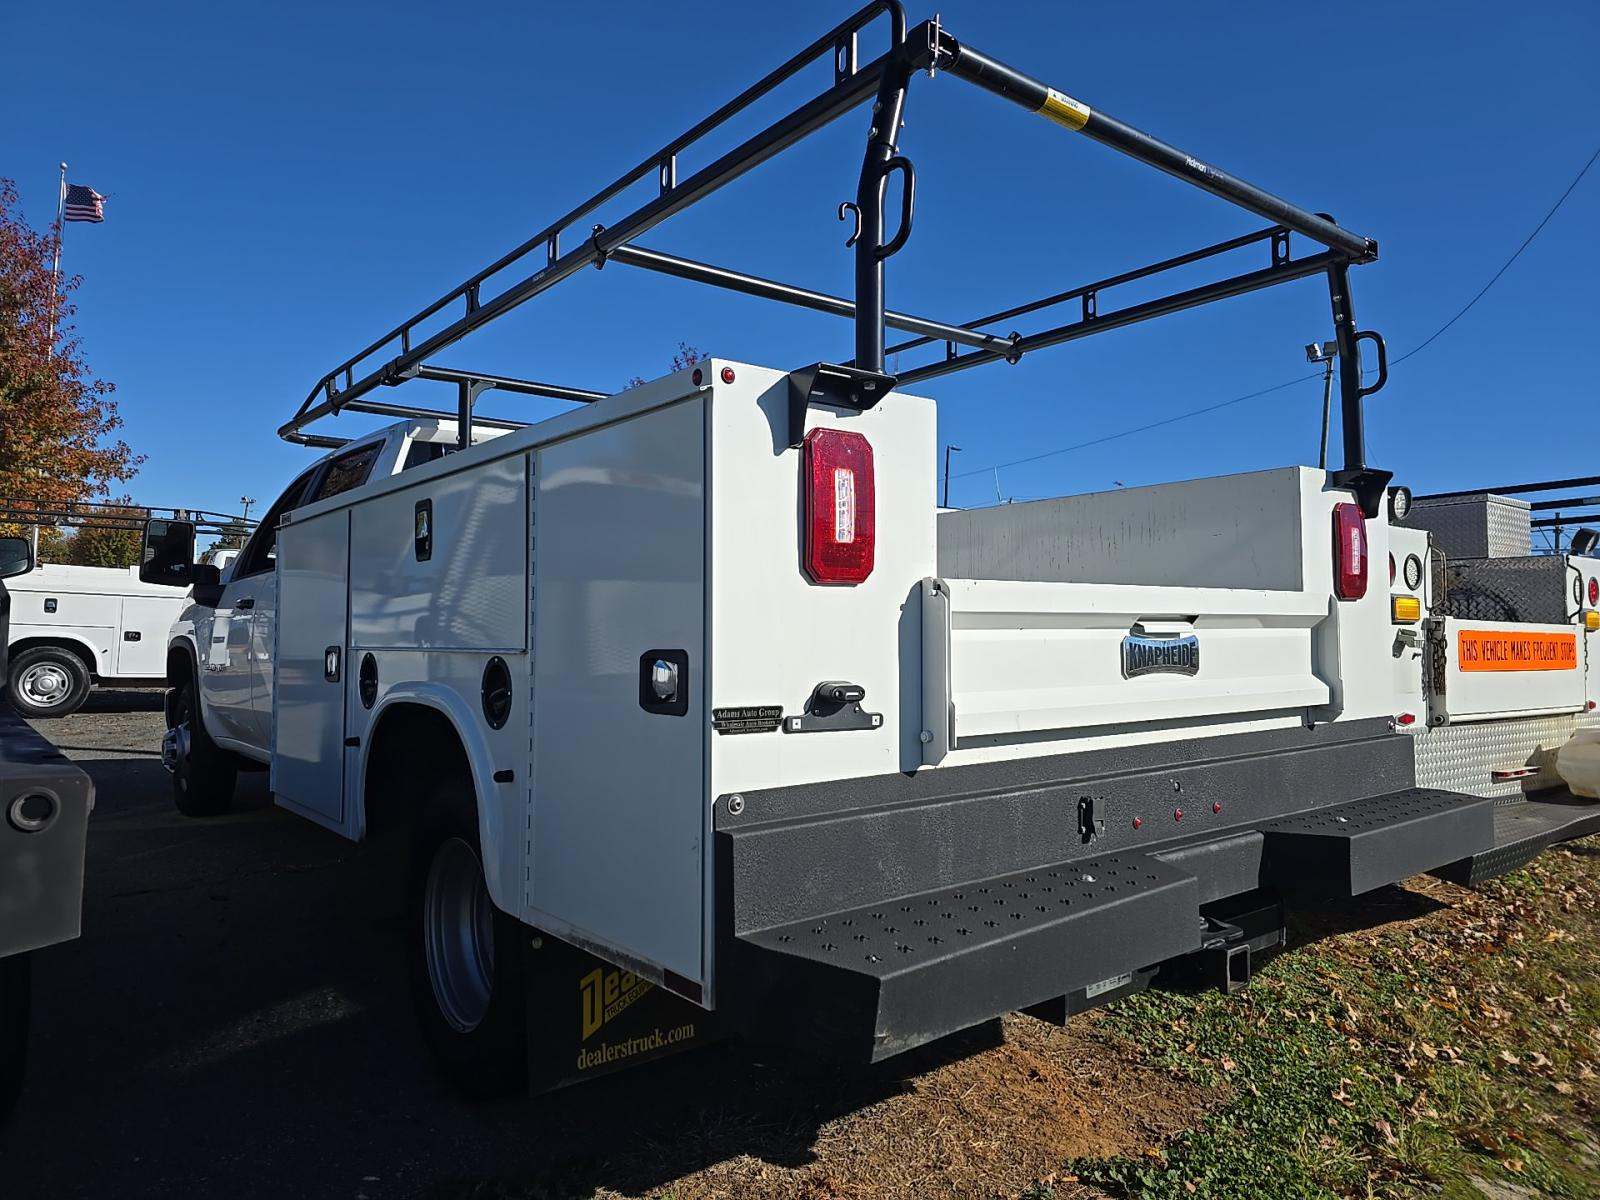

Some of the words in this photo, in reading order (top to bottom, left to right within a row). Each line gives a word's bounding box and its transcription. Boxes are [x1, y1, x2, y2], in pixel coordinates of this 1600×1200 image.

[1128, 641, 1198, 672] KNAPHEIDE
[1461, 640, 1478, 661] THIS
[1481, 640, 1508, 661] VEHICLE
[1510, 641, 1531, 661] MAKES
[1533, 641, 1558, 662] FREQUENT
[1561, 642, 1576, 661] STOPS
[717, 709, 740, 719] Adams
[741, 709, 758, 718] Auto
[758, 707, 780, 718] Group
[577, 1024, 695, 1070] dealerstruck.com
